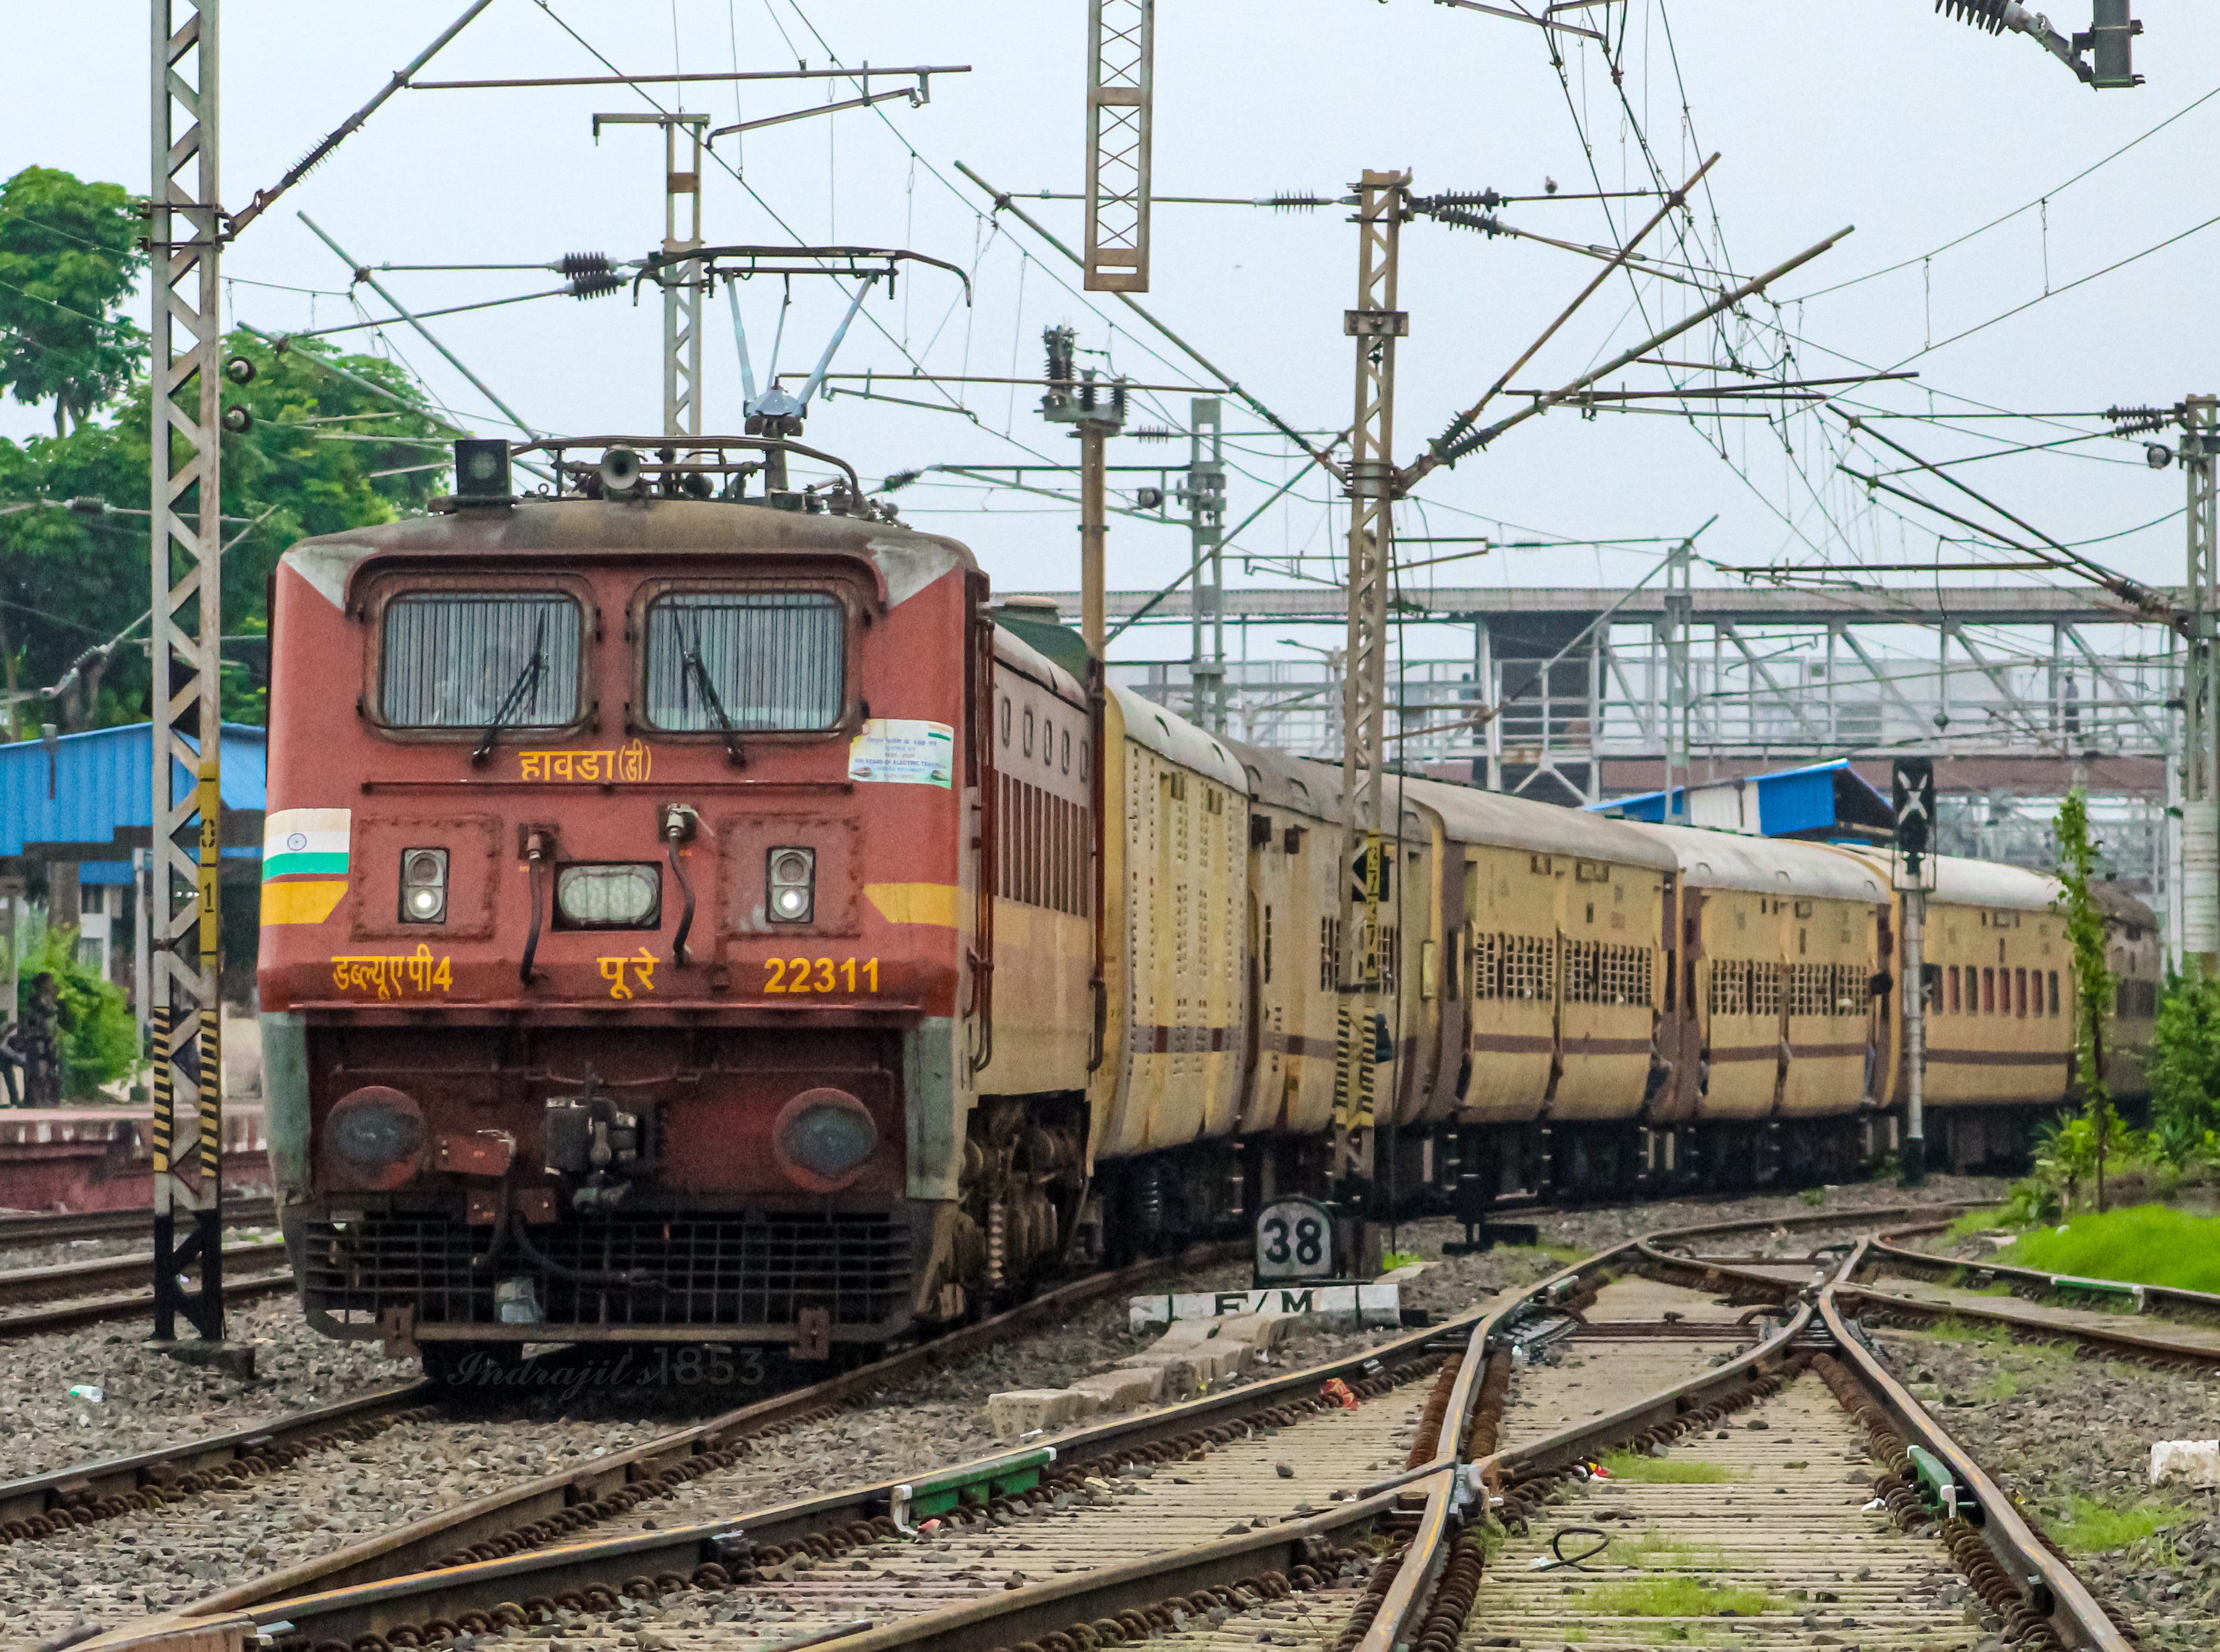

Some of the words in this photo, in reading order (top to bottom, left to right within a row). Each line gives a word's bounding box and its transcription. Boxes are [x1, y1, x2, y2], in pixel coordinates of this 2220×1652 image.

[764, 957, 878, 993] 22311
[1263, 1217, 1323, 1265] 38
[1215, 1290, 1315, 1316] F/M
